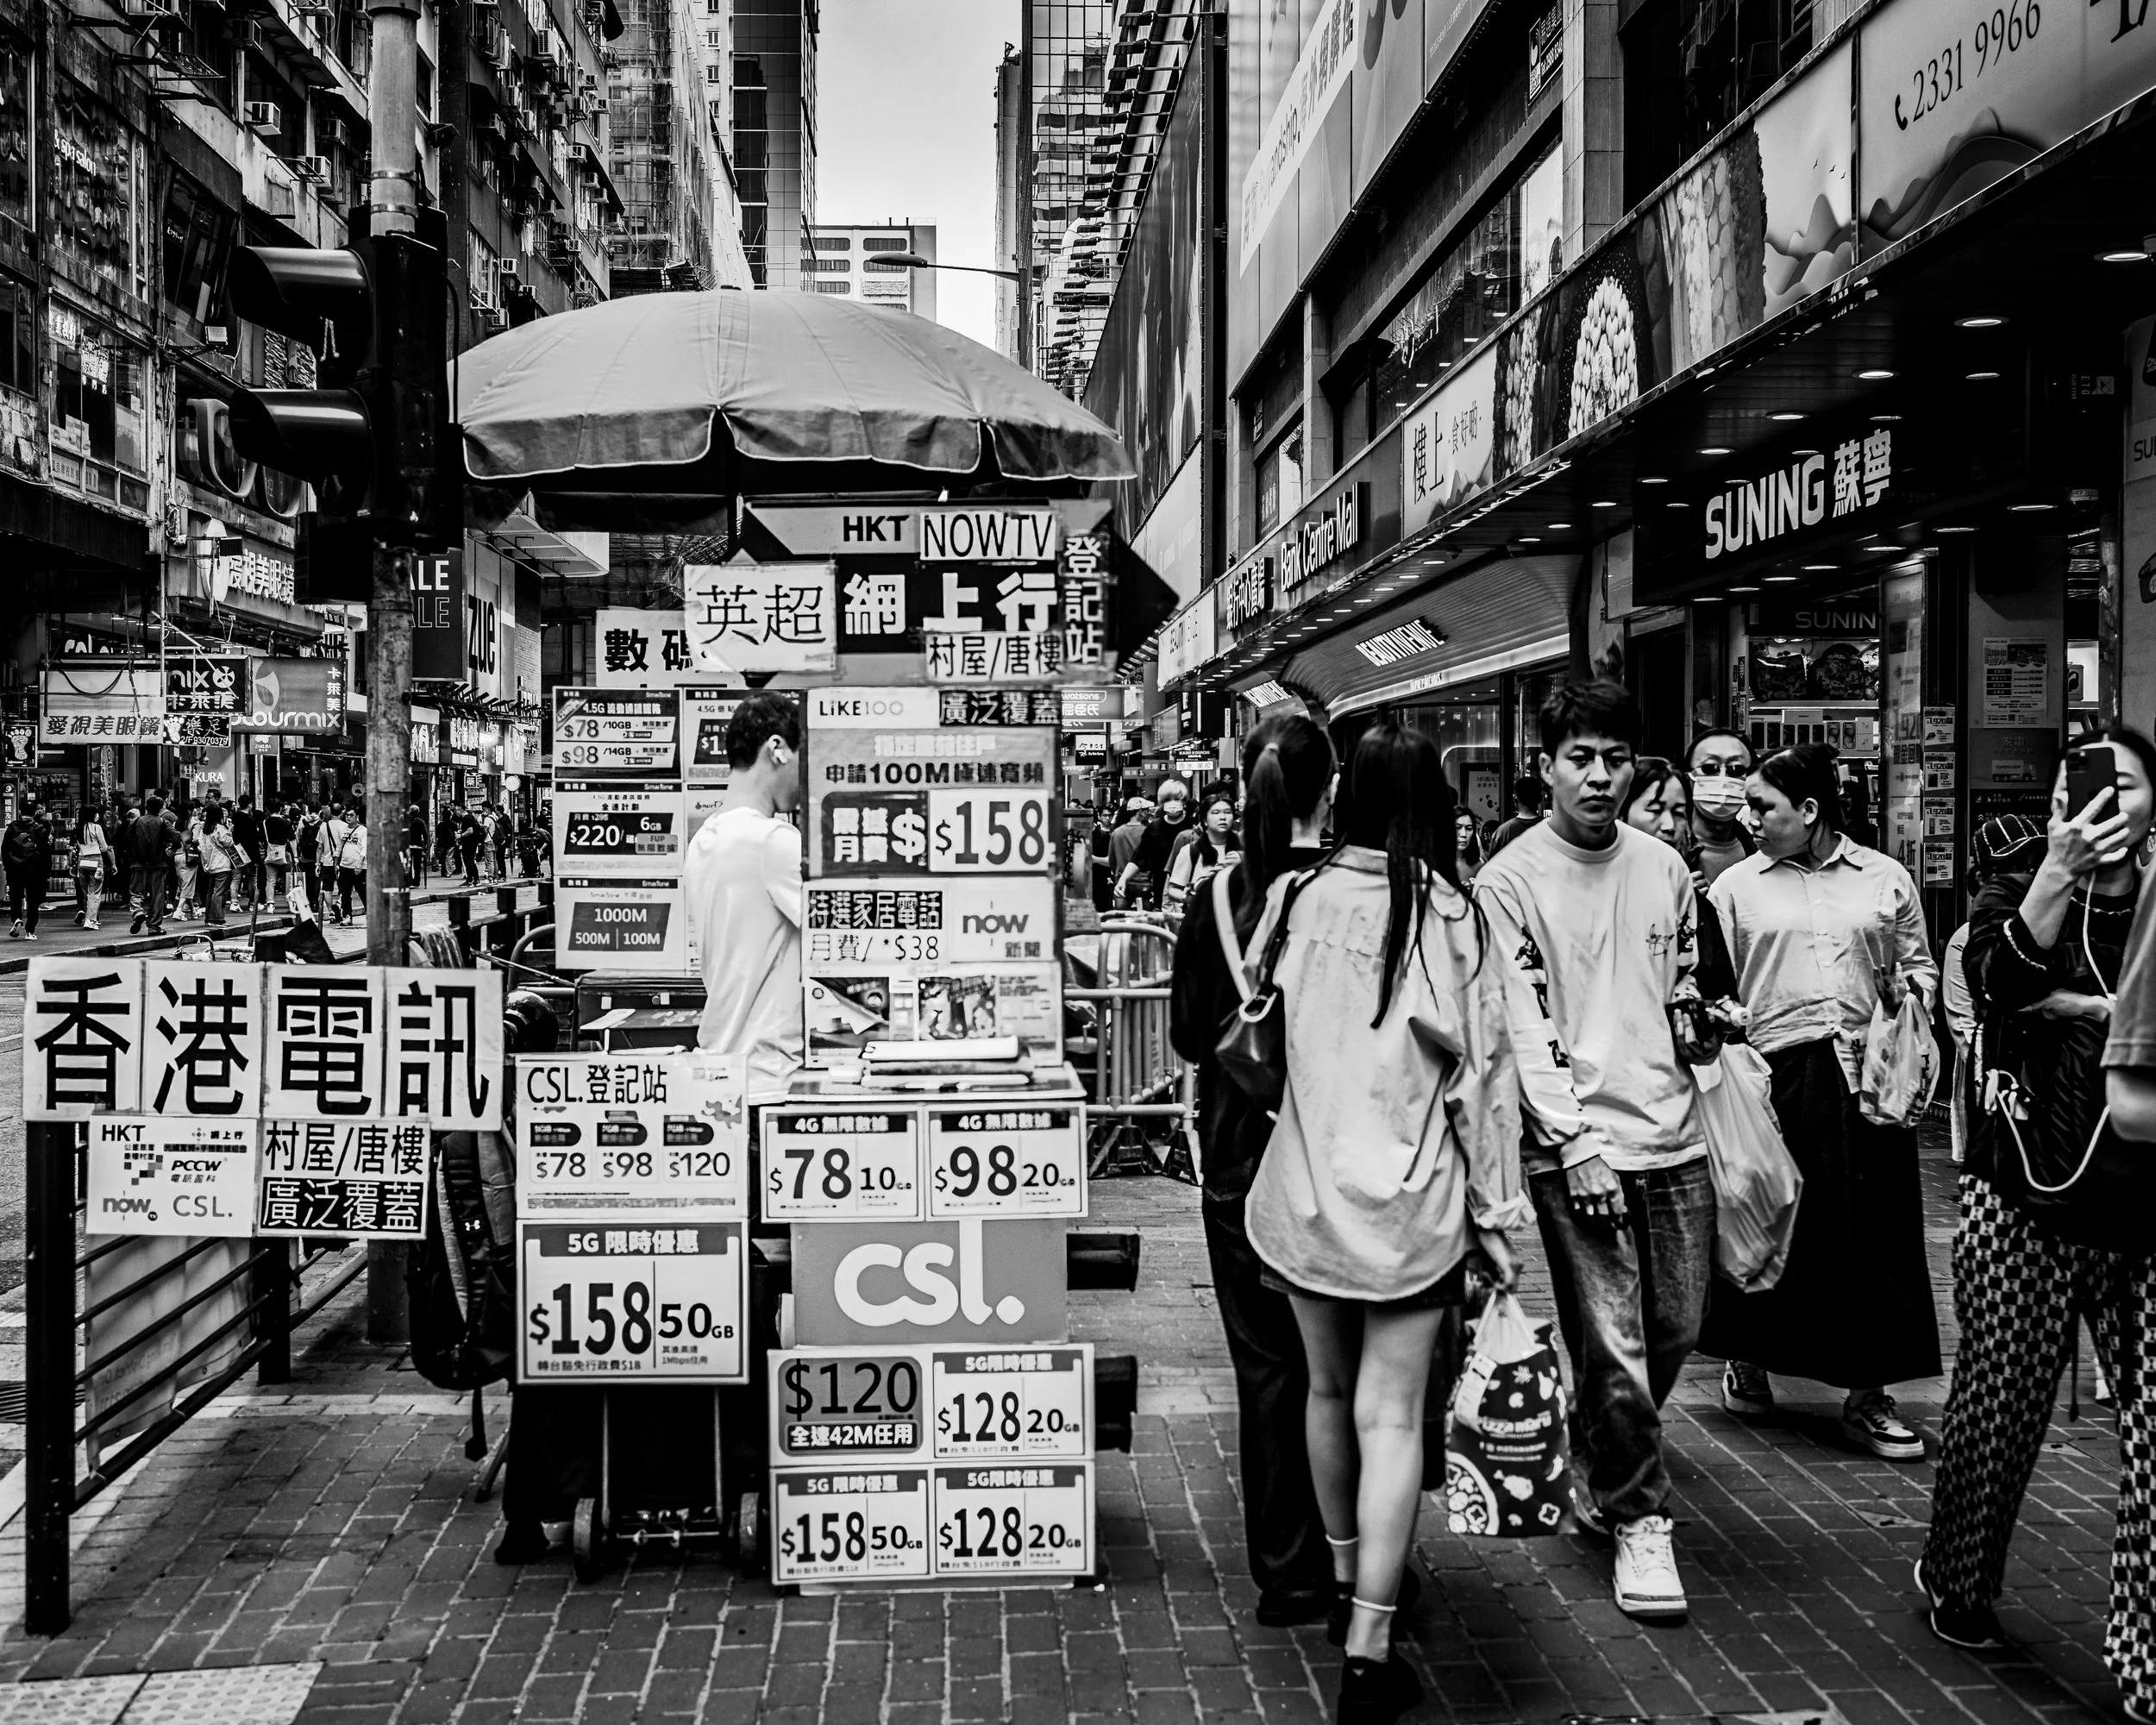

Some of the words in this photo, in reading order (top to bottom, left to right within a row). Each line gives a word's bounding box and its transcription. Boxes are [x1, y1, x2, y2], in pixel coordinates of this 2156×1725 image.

[1913, 39, 1963, 122] 2331
[1975, 0, 2041, 78] 9966
[60, 138, 76, 161] spa
[76, 150, 97, 176] salon
[1413, 411, 1445, 505] 樓上
[2134, 436, 2156, 462] SU
[1705, 453, 1825, 559] SUNING
[1833, 429, 1891, 518] 蘇寧
[843, 516, 909, 543] HKT
[924, 515, 1051, 558] NOWTV
[1282, 531, 1301, 593] Bank
[1303, 511, 1334, 577] Centre
[1337, 482, 1358, 555] Mall
[411, 561, 449, 590] LE
[1226, 556, 1265, 630] 銀行中心廣場
[412, 597, 449, 628] LE
[696, 584, 826, 646] 英超
[844, 573, 1057, 635] 網上行
[1063, 536, 1104, 663] 登記站
[929, 635, 1062, 679] 村屋/唐樓
[327, 667, 342, 711] 卡萊美
[46, 715, 161, 736] 愛視美眼鏡
[939, 690, 1061, 725] 廣泛覆蓋
[564, 719, 599, 738] $78
[561, 745, 599, 764] $98
[640, 816, 662, 831] 6GB
[936, 799, 1045, 866] $158
[594, 907, 648, 923] 1000M
[962, 914, 1030, 934] now
[575, 932, 611, 945] 500M
[623, 932, 661, 945] 100M
[34, 972, 490, 1117] 香港電訊
[102, 1124, 146, 1142] HKT
[794, 1118, 819, 1132] 4G
[958, 1114, 982, 1130] 4G
[171, 1160, 222, 1172] PCCW
[265, 1125, 426, 1176] 村屋/唐樓
[536, 1152, 586, 1178] $78
[603, 1152, 653, 1178] $98
[669, 1152, 731, 1178] $120
[769, 1148, 852, 1199] $78
[934, 1145, 1018, 1197] $98
[103, 1197, 152, 1214] now
[172, 1195, 233, 1218] CSL.
[262, 1178, 423, 1231] 廣泛覆蓋
[567, 1233, 599, 1254] 5G
[834, 1220, 1026, 1327] csl.
[529, 1281, 653, 1356] $158
[785, 1358, 918, 1422] $120
[937, 1391, 1021, 1442] $128
[790, 1423, 913, 1447] 全速42M任用
[807, 1478, 830, 1494] 5G
[780, 1511, 867, 1564] $158
[938, 1506, 1024, 1559] $128
